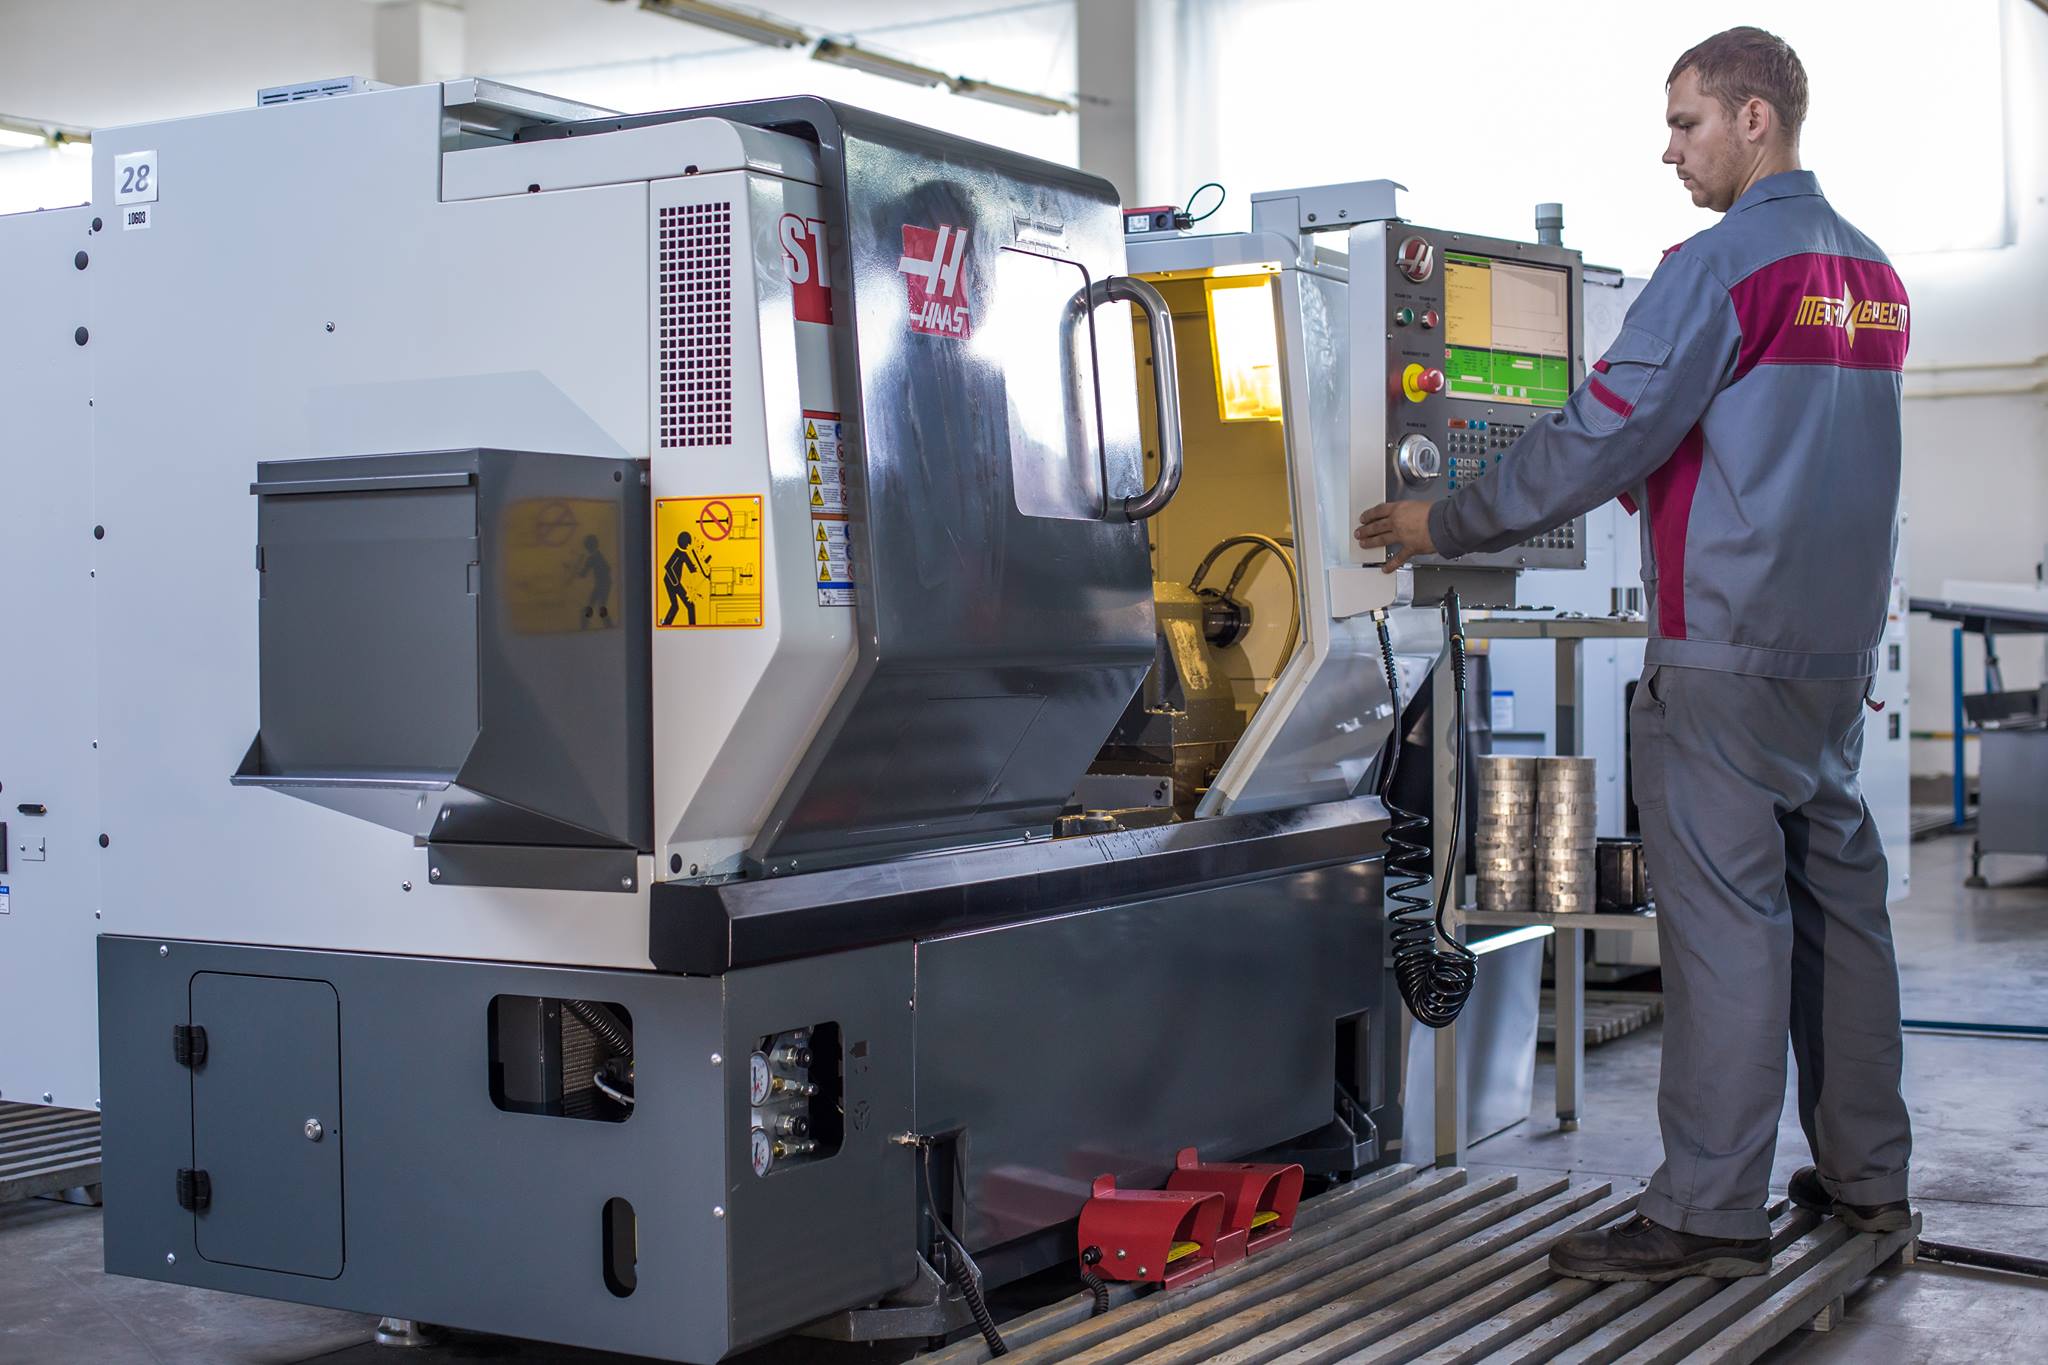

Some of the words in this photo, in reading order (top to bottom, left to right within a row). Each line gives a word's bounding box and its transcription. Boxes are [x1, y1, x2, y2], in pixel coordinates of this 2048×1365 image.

[121, 164, 150, 194] 28
[127, 211, 146, 225] 10603
[909, 300, 970, 334] HAAS
